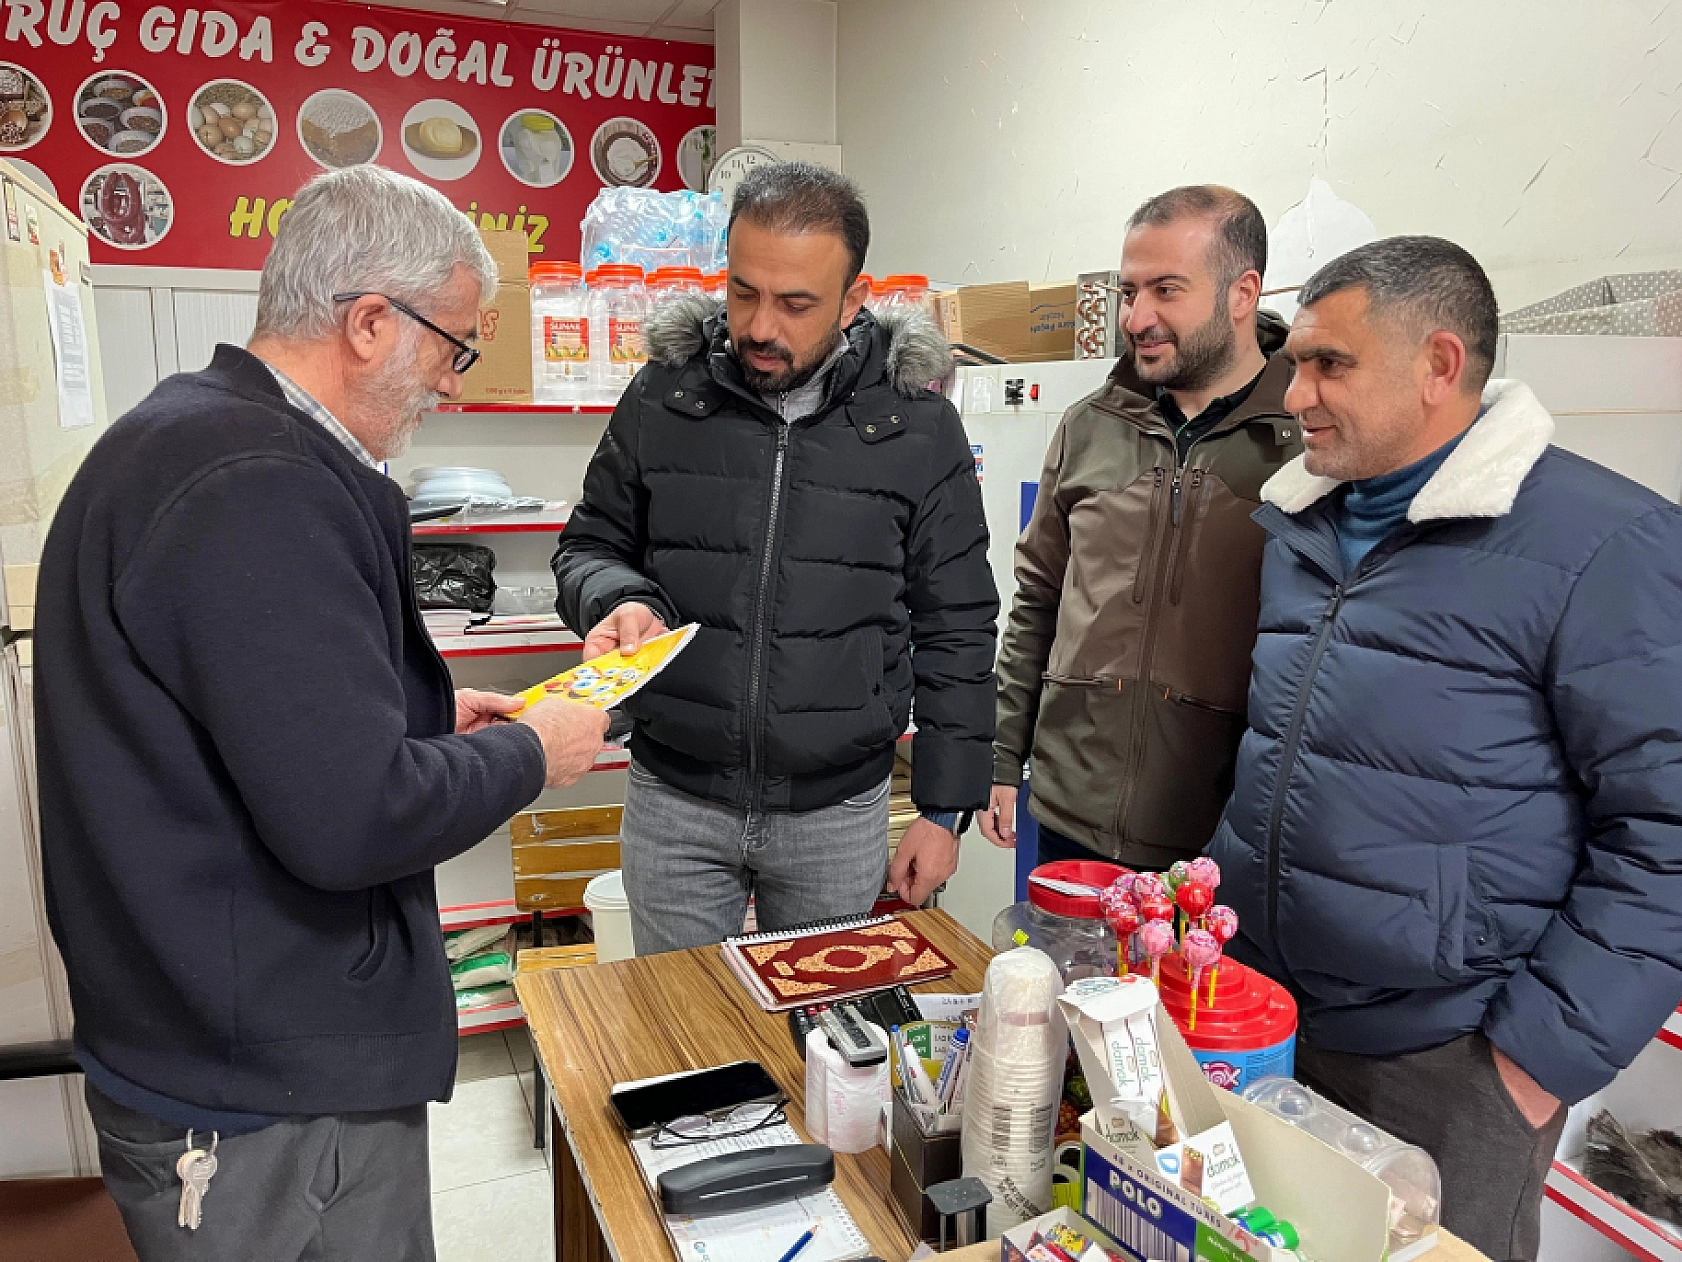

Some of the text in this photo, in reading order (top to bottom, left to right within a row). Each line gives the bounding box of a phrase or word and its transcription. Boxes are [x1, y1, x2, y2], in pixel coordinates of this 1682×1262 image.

[0, 0, 120, 63] RUÇ
[139, 5, 273, 63] GIDA
[294, 21, 331, 67] &
[351, 26, 514, 87] DOĞAL
[1111, 1040, 1135, 1088] damak
[1206, 1142, 1241, 1179] damak
[1109, 1169, 1163, 1219] POLO
[1136, 1169, 1188, 1206] ORIGINAL
